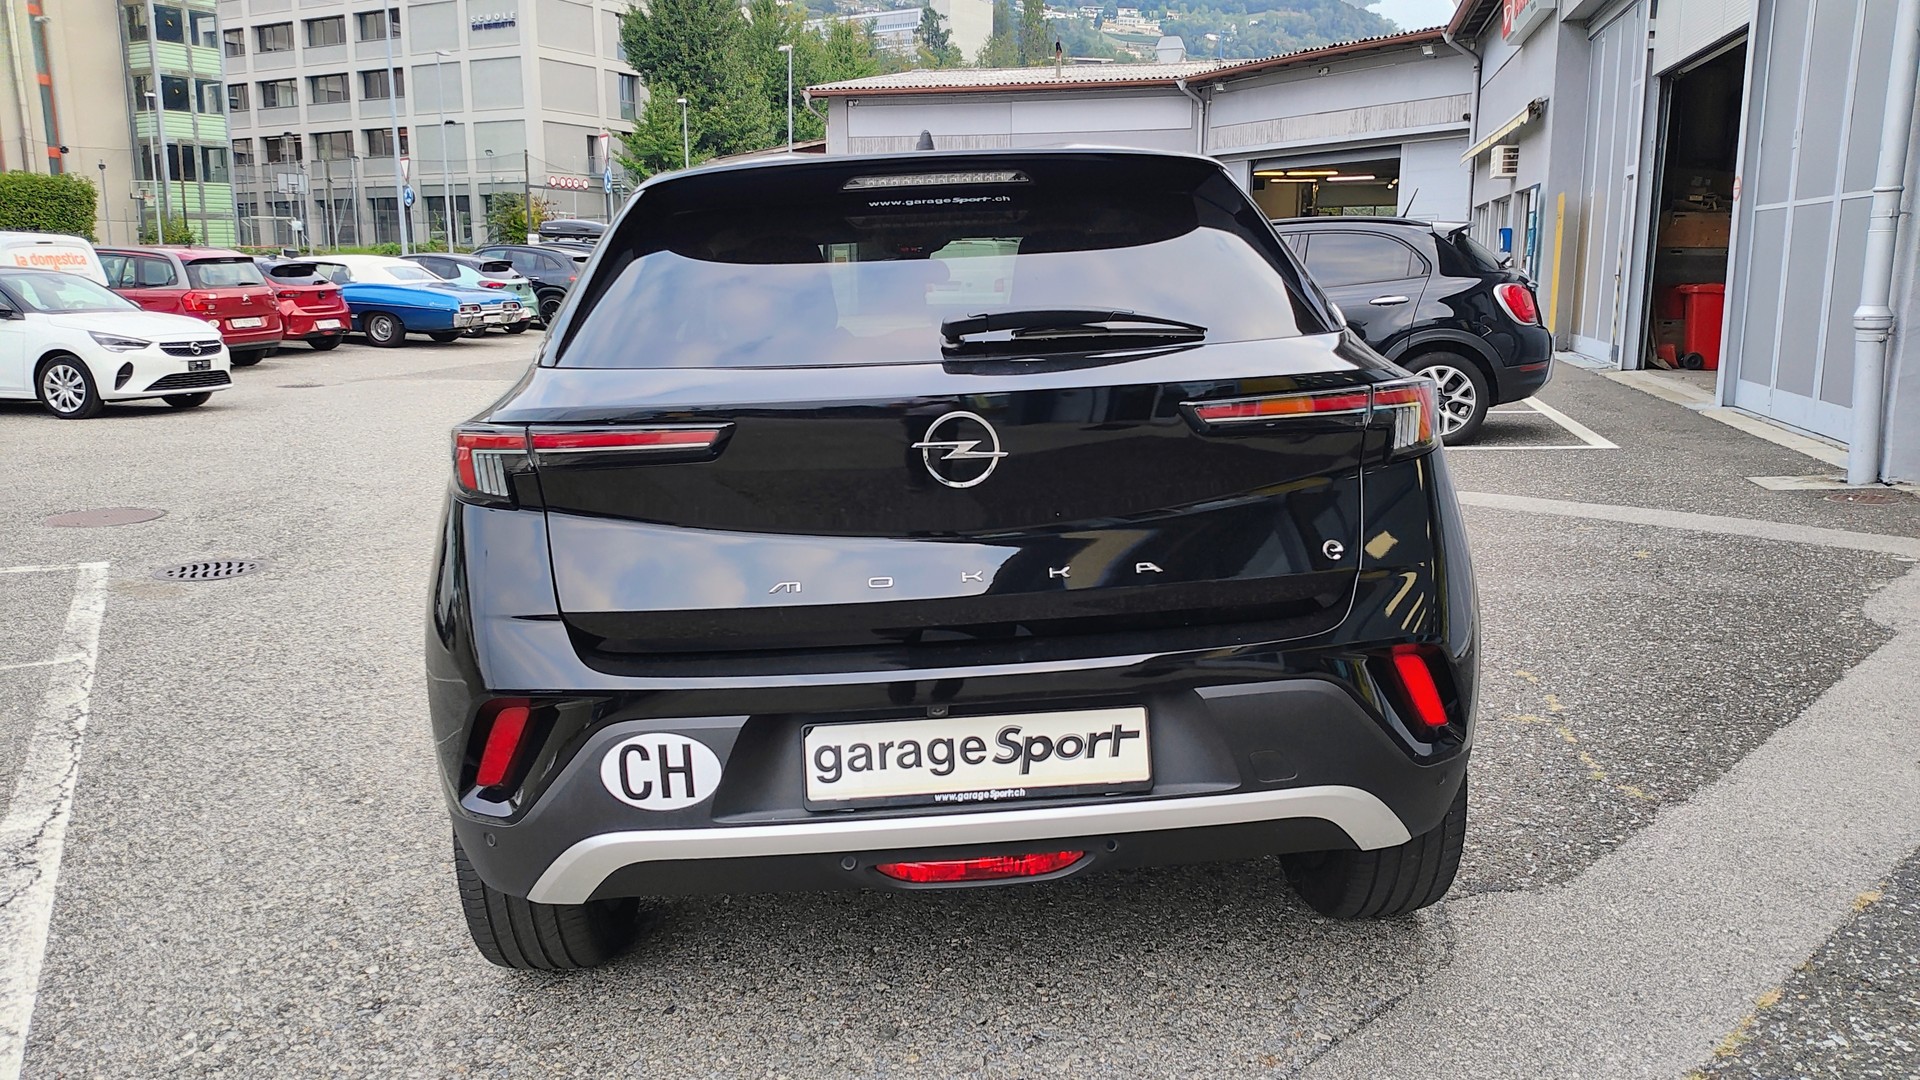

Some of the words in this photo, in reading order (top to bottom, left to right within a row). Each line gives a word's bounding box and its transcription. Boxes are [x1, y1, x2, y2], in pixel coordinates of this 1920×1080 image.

[470, 12, 516, 23] SCUOLE
[14, 253, 28, 267] la
[29, 252, 87, 271] domestica
[618, 743, 696, 801] CH
